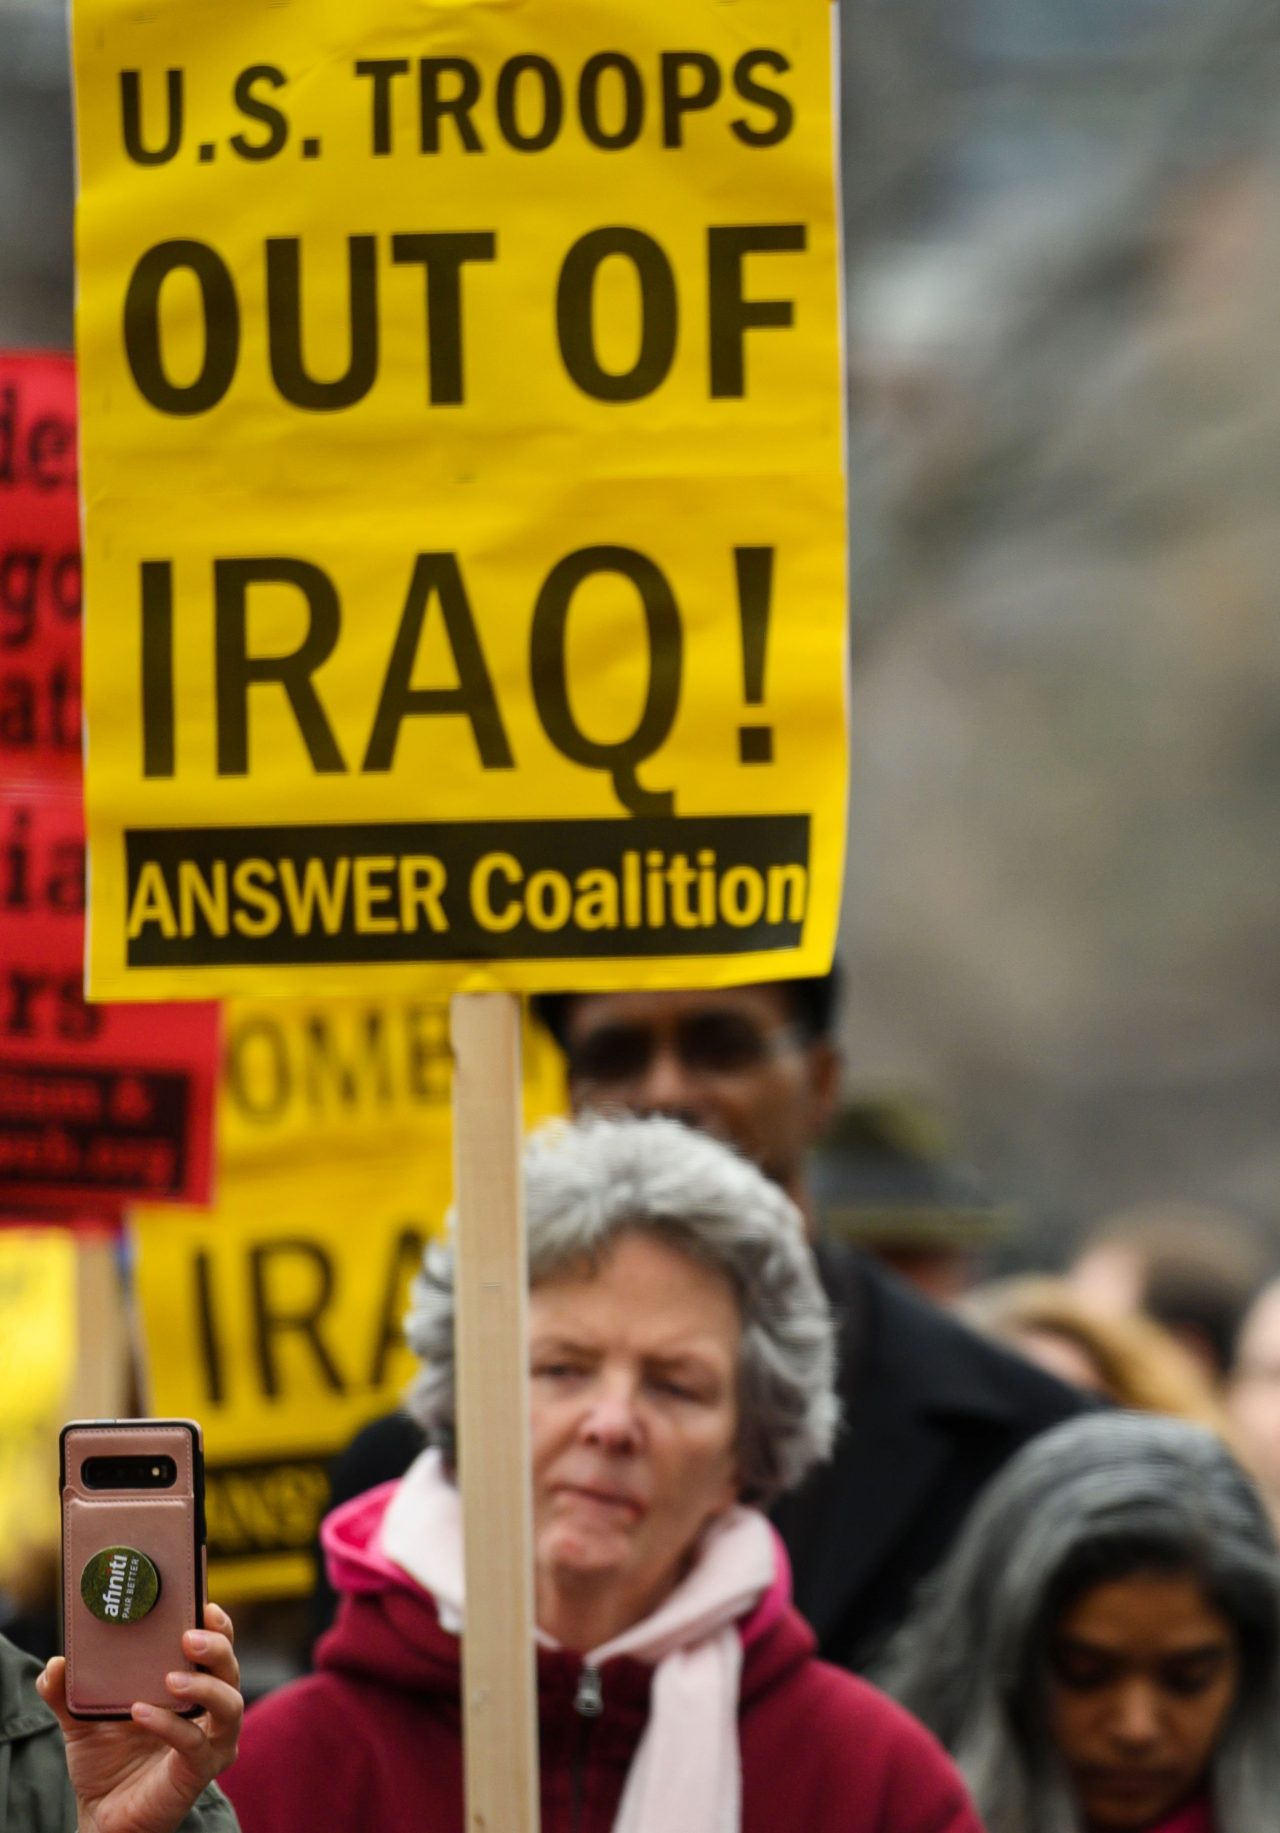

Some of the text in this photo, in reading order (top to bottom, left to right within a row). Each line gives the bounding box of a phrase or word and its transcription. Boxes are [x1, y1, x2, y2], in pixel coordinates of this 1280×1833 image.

[119, 48, 794, 167] U.S. TROOPS
[122, 222, 807, 417] OUT OF
[139, 544, 776, 817] IRAQ!
[126, 850, 807, 939] ANSWER Coalition
[102, 1553, 127, 1617] afiniti
[122, 1557, 139, 1619] PAIR BETTER
